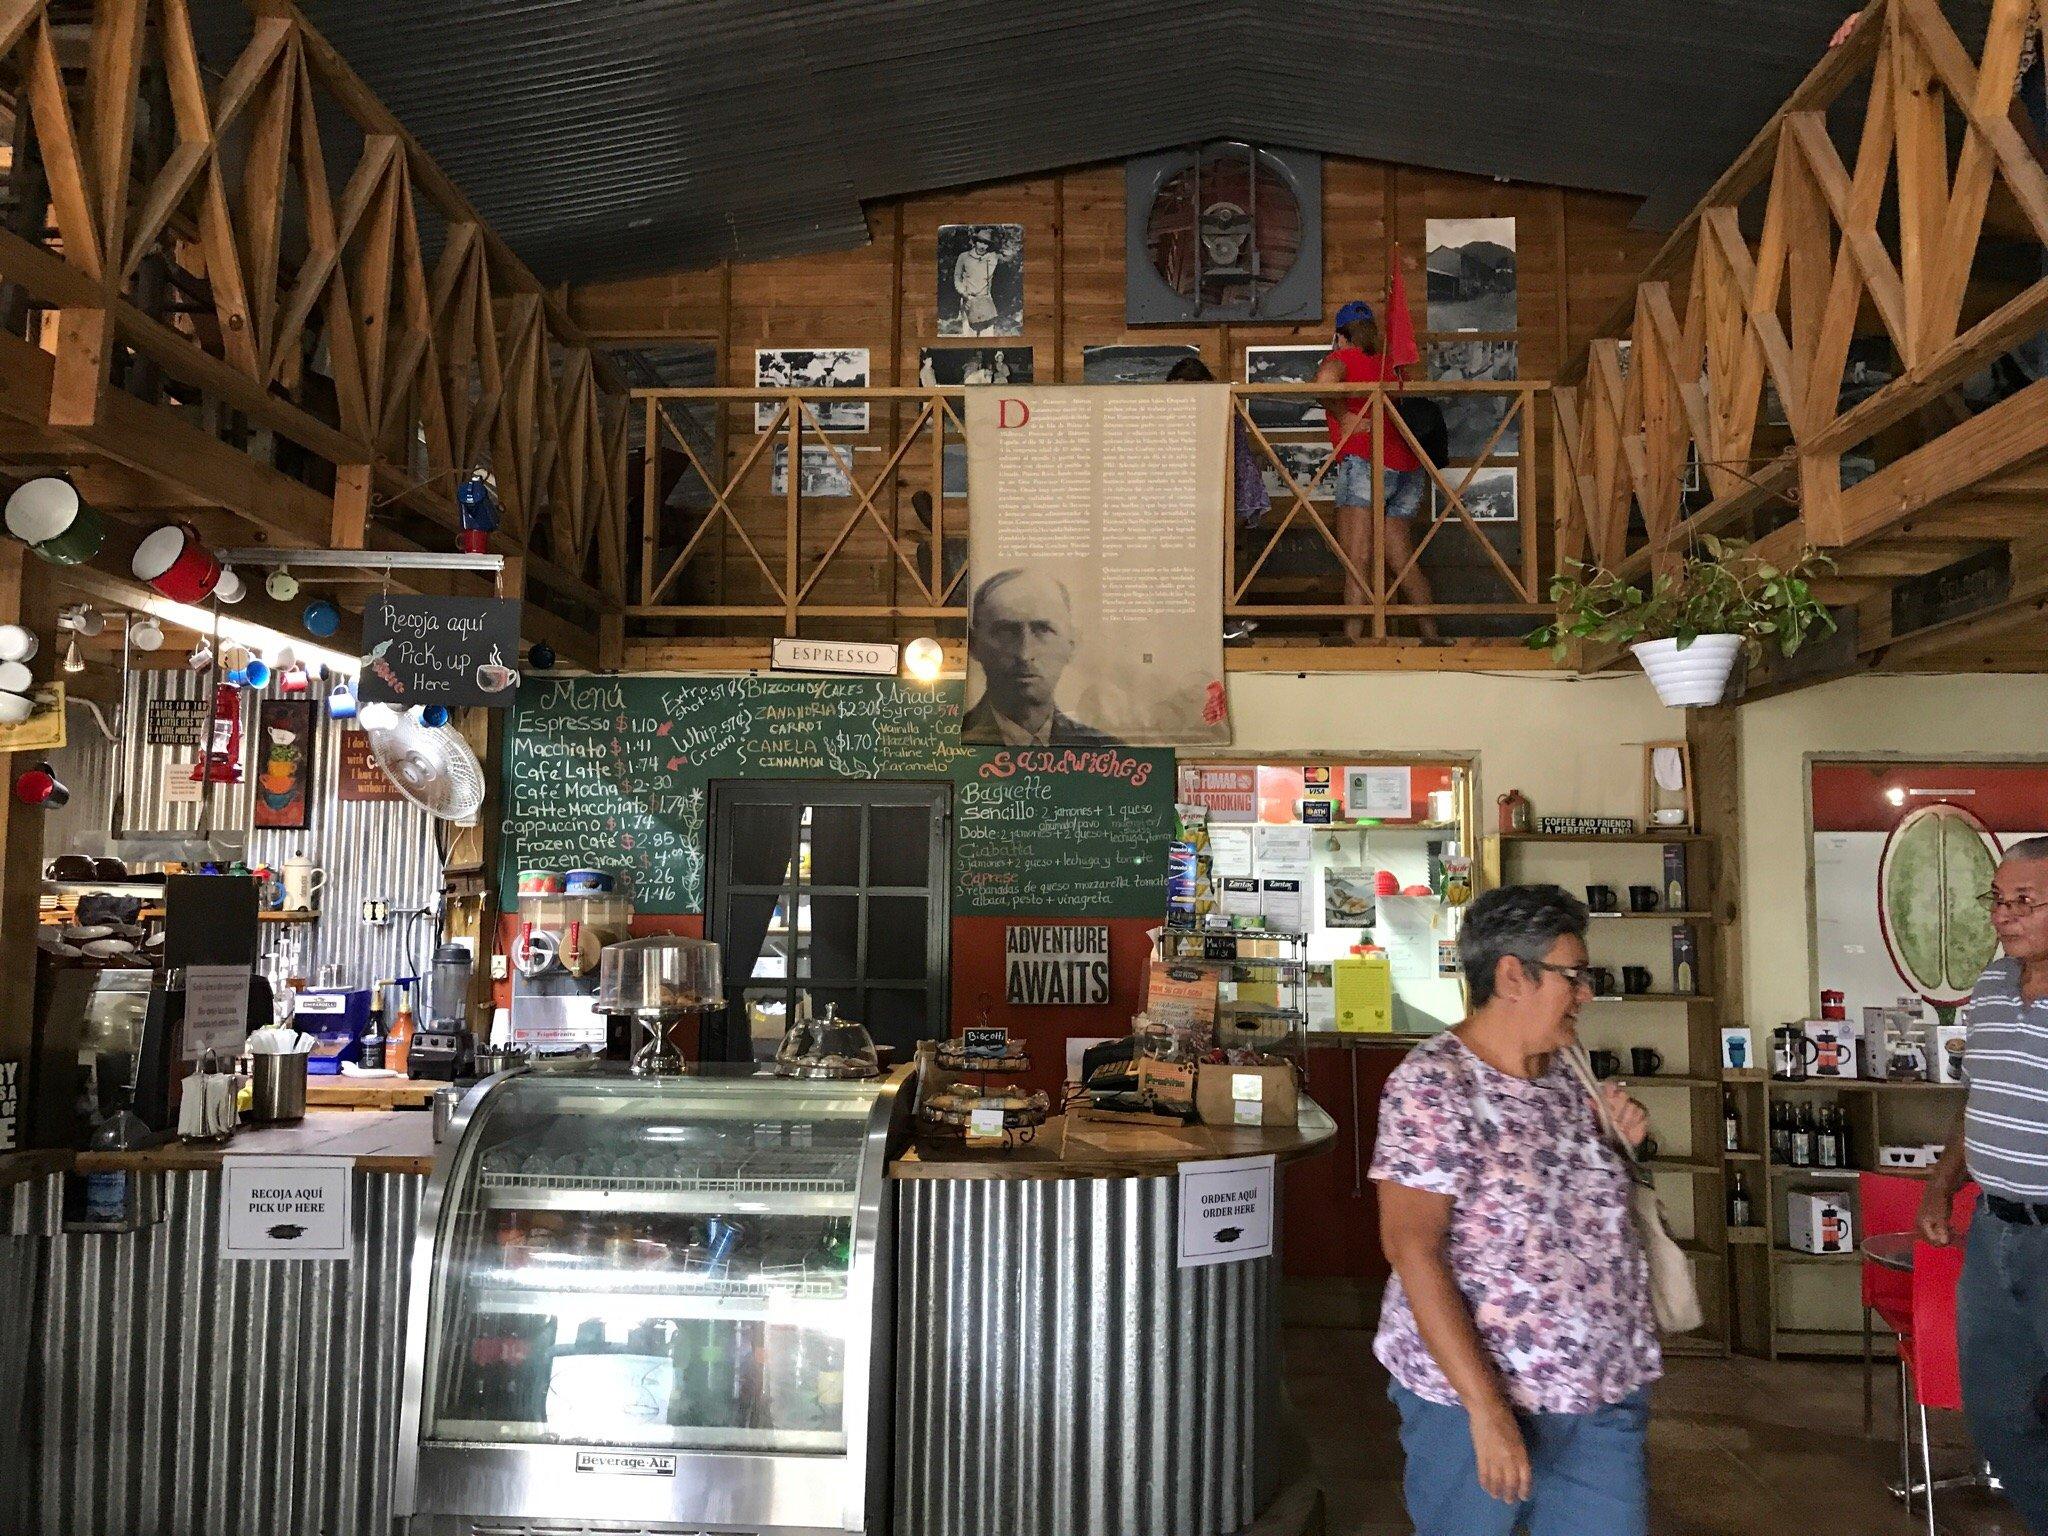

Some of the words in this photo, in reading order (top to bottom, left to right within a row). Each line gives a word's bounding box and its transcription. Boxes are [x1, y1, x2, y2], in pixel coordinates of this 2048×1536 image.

[379, 604, 440, 639] Recoja
[447, 612, 487, 641] aquí
[398, 641, 441, 670] Pick
[447, 654, 471, 676] up
[792, 647, 879, 664] ESPRESSO
[413, 673, 451, 691] Here
[540, 677, 628, 711] Menú
[661, 684, 708, 716] Extra
[881, 682, 947, 705] Añade
[518, 710, 610, 739] Espresso
[769, 721, 823, 735] CARROT
[514, 735, 607, 759] Macchiato
[671, 725, 718, 754] Whip
[746, 739, 818, 754] CANELA
[690, 734, 736, 767] Cream
[514, 760, 562, 781] Café
[565, 759, 612, 782] Latte
[758, 756, 825, 769] CINNAMON
[979, 749, 1153, 786] Sandwiches
[514, 782, 560, 802] Café
[565, 777, 619, 800] Mocha
[961, 776, 1052, 804] Baguette
[1308, 788, 1326, 796] VISA
[515, 800, 568, 819] Latte
[568, 796, 649, 816] Macchiato
[1204, 794, 1252, 812] SMOKING
[1041, 807, 1049, 819] 2
[1107, 805, 1116, 817] 1
[1119, 804, 1153, 821] queso
[501, 817, 601, 839] Cappuccino
[1544, 817, 1576, 827] COFFEE
[1578, 818, 1595, 827] AND
[1597, 819, 1632, 828] FRIENDS
[1545, 826, 1552, 834] A
[1555, 826, 1598, 835] PERFECT
[1600, 827, 1632, 835] BLEND
[516, 837, 575, 853] Frozen
[579, 831, 619, 851] Café
[1000, 830, 1007, 840] 2
[1064, 830, 1072, 840] 2
[517, 854, 581, 870] Frozen
[583, 850, 637, 869] Grande
[1014, 859, 1021, 868] 2
[1024, 881, 1037, 893] de
[1040, 882, 1070, 894] queso
[1228, 879, 1254, 888] Zantac
[1269, 880, 1293, 888] Zantac
[1012, 894, 1044, 909] pesto
[1007, 926, 1107, 954] ADVENTURE
[1007, 960, 1108, 1004] AWAITS
[967, 1031, 1005, 1042] Biscotti
[251, 1189, 292, 1200] RECOJA
[295, 1187, 323, 1200] AQUÍ
[1201, 1192, 1236, 1205] ORDENE
[1237, 1187, 1257, 1201] AQUÍ
[249, 1203, 275, 1213] PICK
[277, 1203, 292, 1213] UP
[295, 1203, 325, 1213] HERE
[1202, 1206, 1233, 1219] ORDER
[1234, 1203, 1256, 1216] HERE
